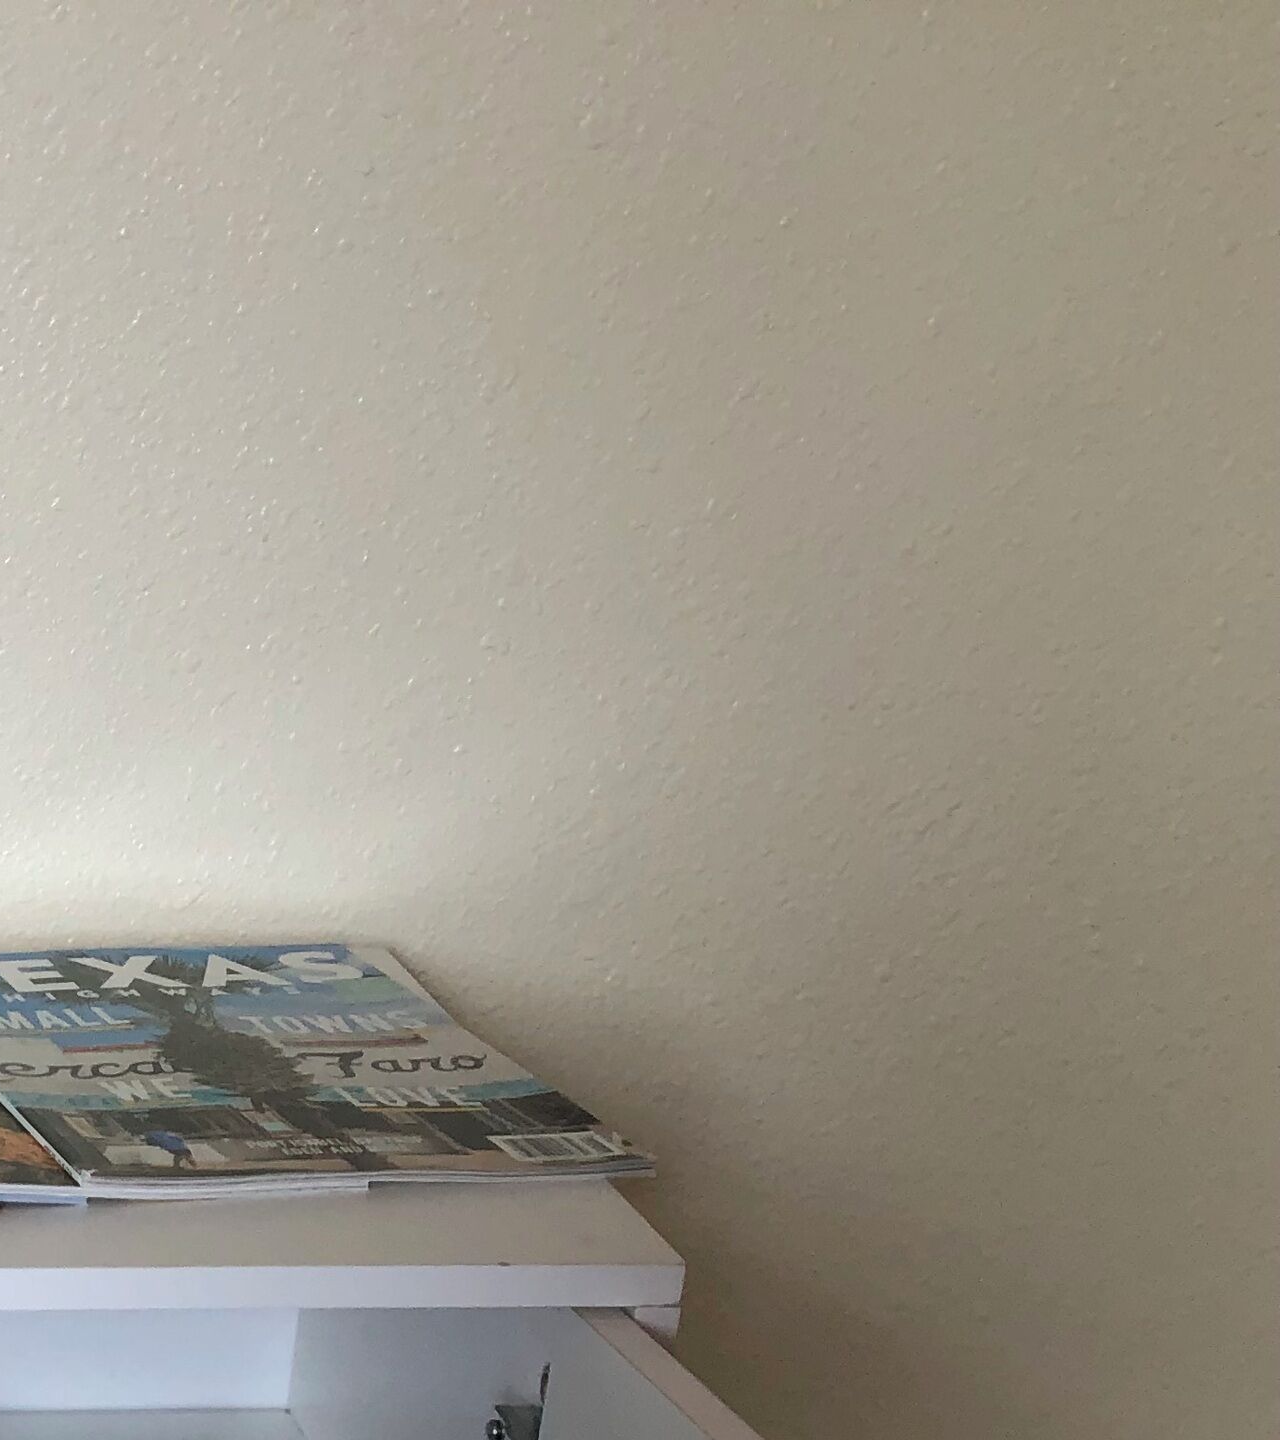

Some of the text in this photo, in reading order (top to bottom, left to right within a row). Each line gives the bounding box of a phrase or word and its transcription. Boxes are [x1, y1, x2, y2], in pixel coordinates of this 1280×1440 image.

[1, 984, 300, 1003] HIGHWAYS
[237, 1009, 430, 1035] TOWNS
[100, 1077, 482, 1108] WE LOVE
